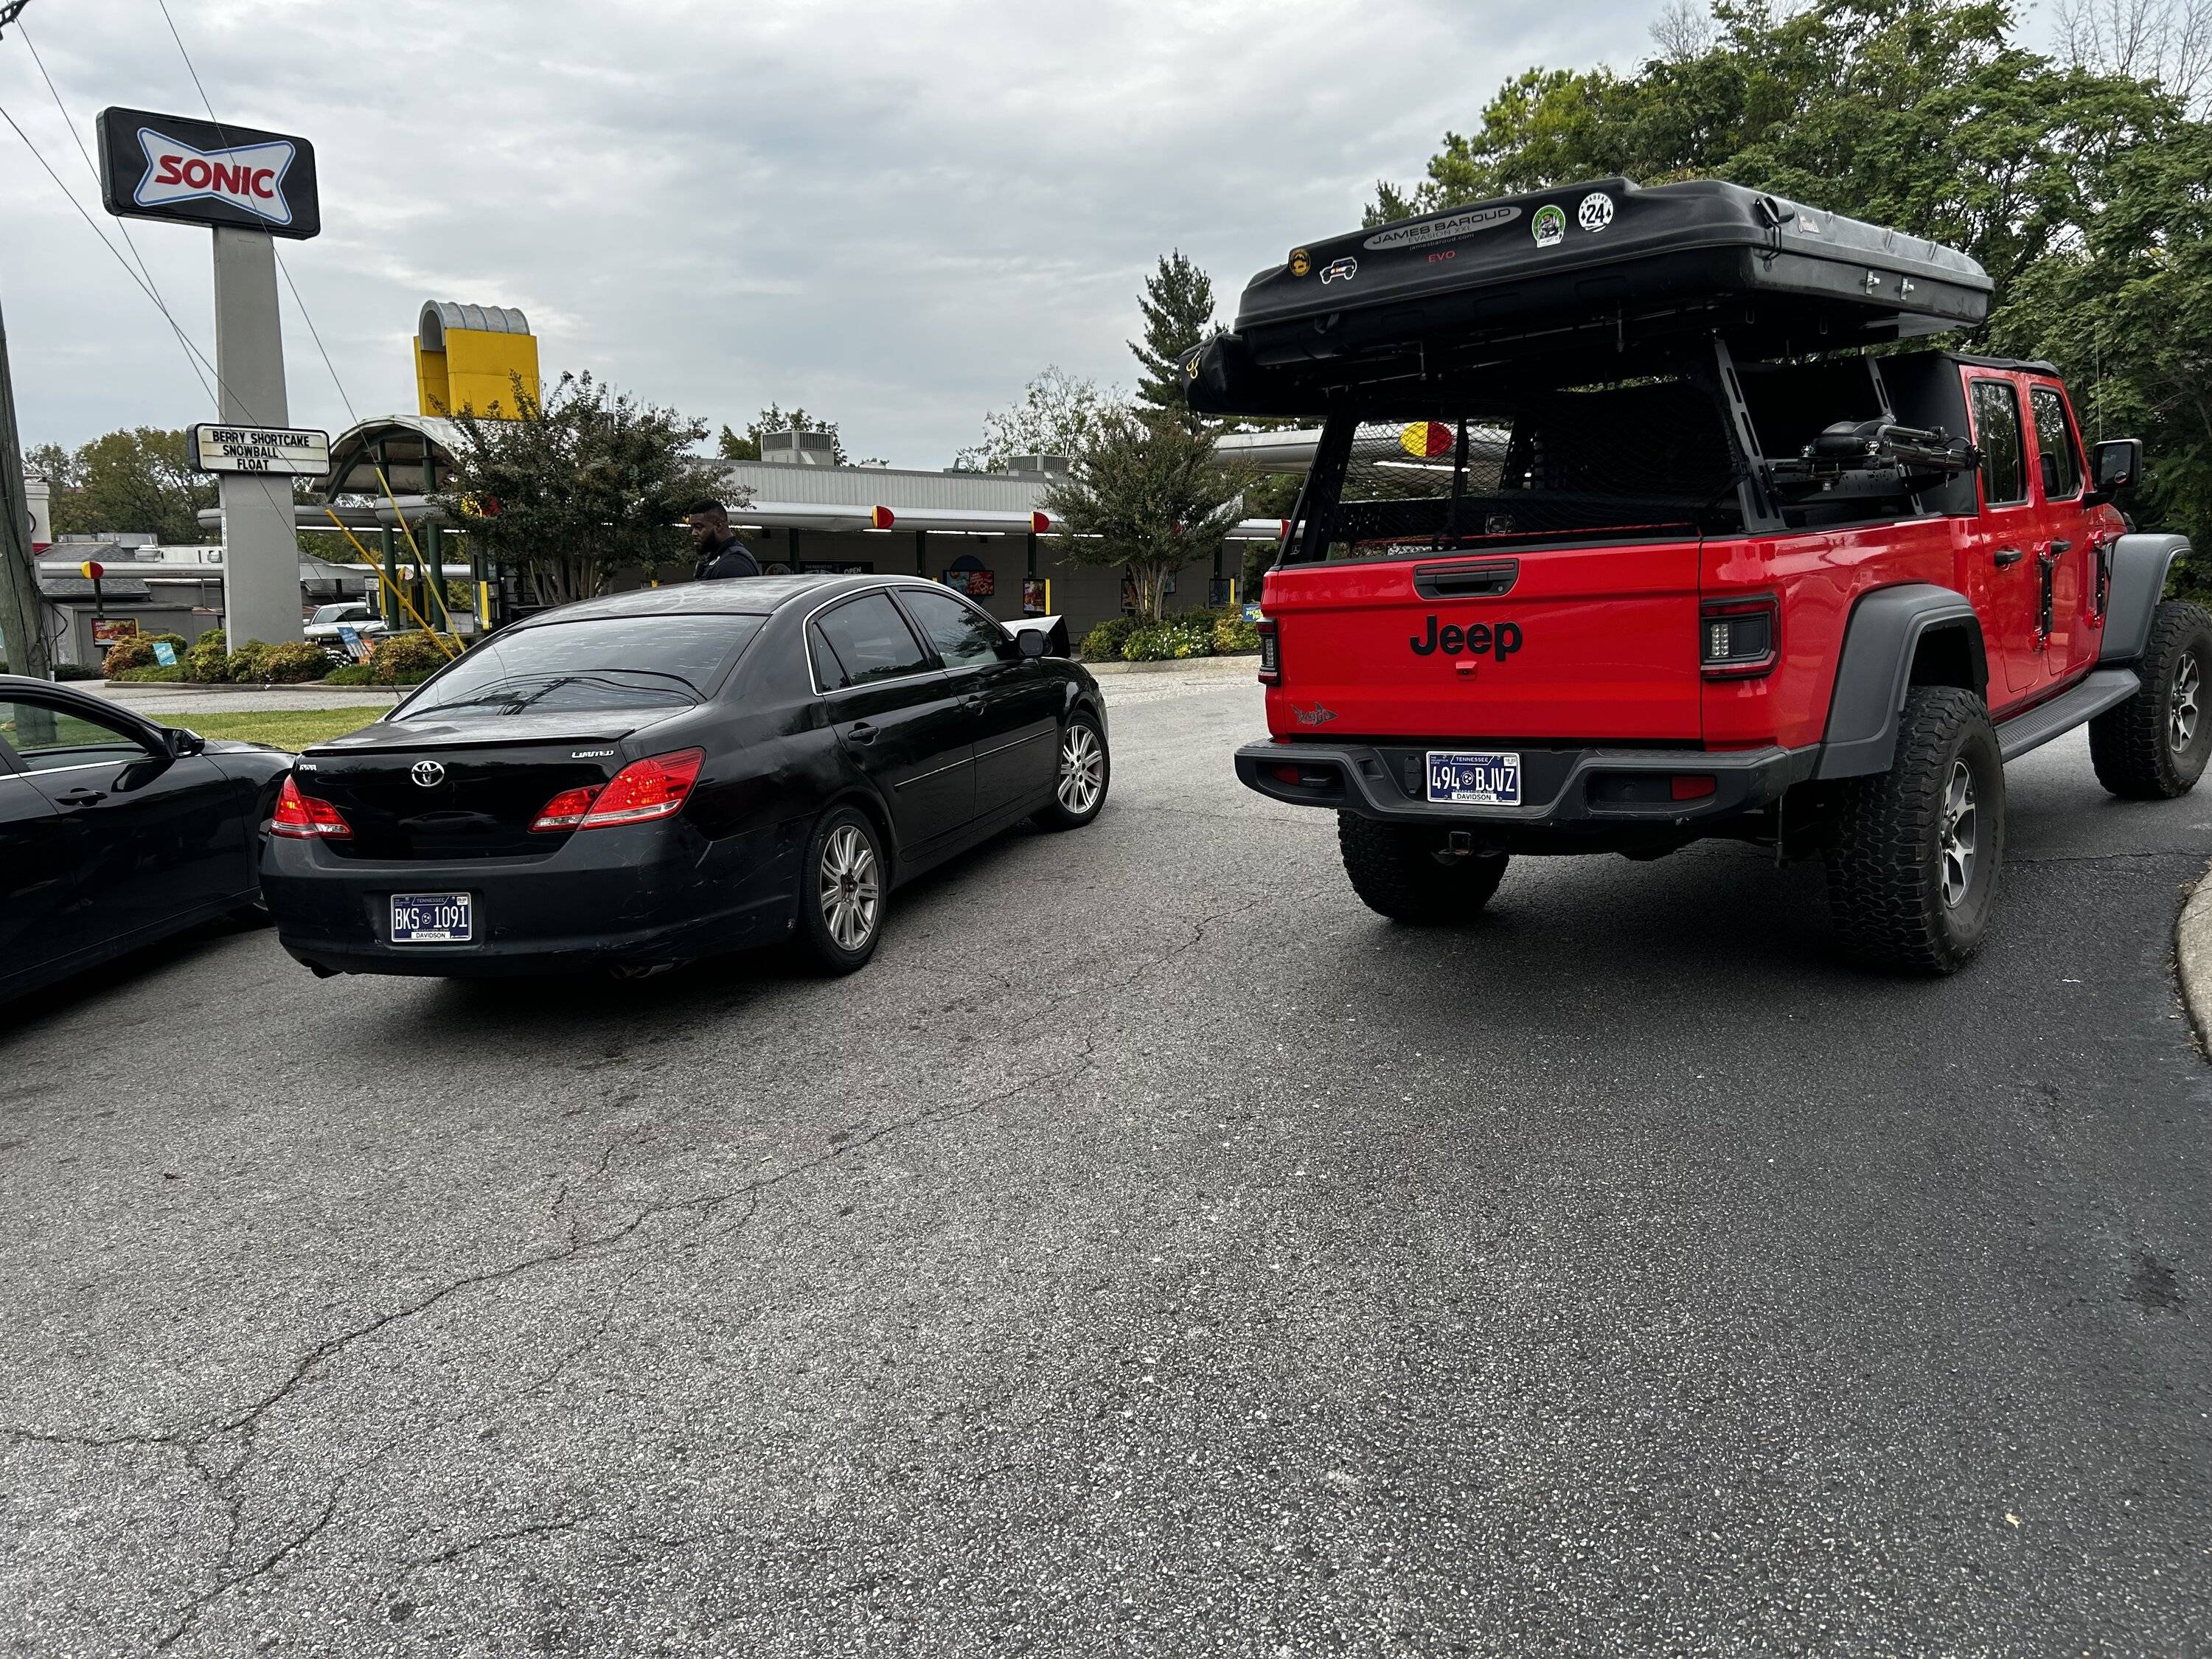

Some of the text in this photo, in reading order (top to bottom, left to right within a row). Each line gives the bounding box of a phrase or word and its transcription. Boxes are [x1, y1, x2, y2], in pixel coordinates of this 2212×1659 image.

[154, 155, 275, 198] SONIC
[1586, 203, 1604, 224] 24
[1373, 226, 1430, 245] JAMES
[1435, 208, 1511, 232] BAROUD
[1409, 229, 1451, 243] EVASION
[1409, 234, 1475, 251] jamesbaroud.com
[1427, 250, 1456, 263] EVO
[212, 431, 310, 447] BERRY SHORTCAKE
[223, 445, 279, 458] SNOWBALL
[237, 459, 269, 470] FLOAT
[844, 566, 862, 576] OPEN
[1410, 614, 1522, 661] Jeep
[571, 750, 614, 759] LIMITED
[1432, 766, 1515, 792] 494 BJVZ
[394, 905, 468, 930] BKS 1091
